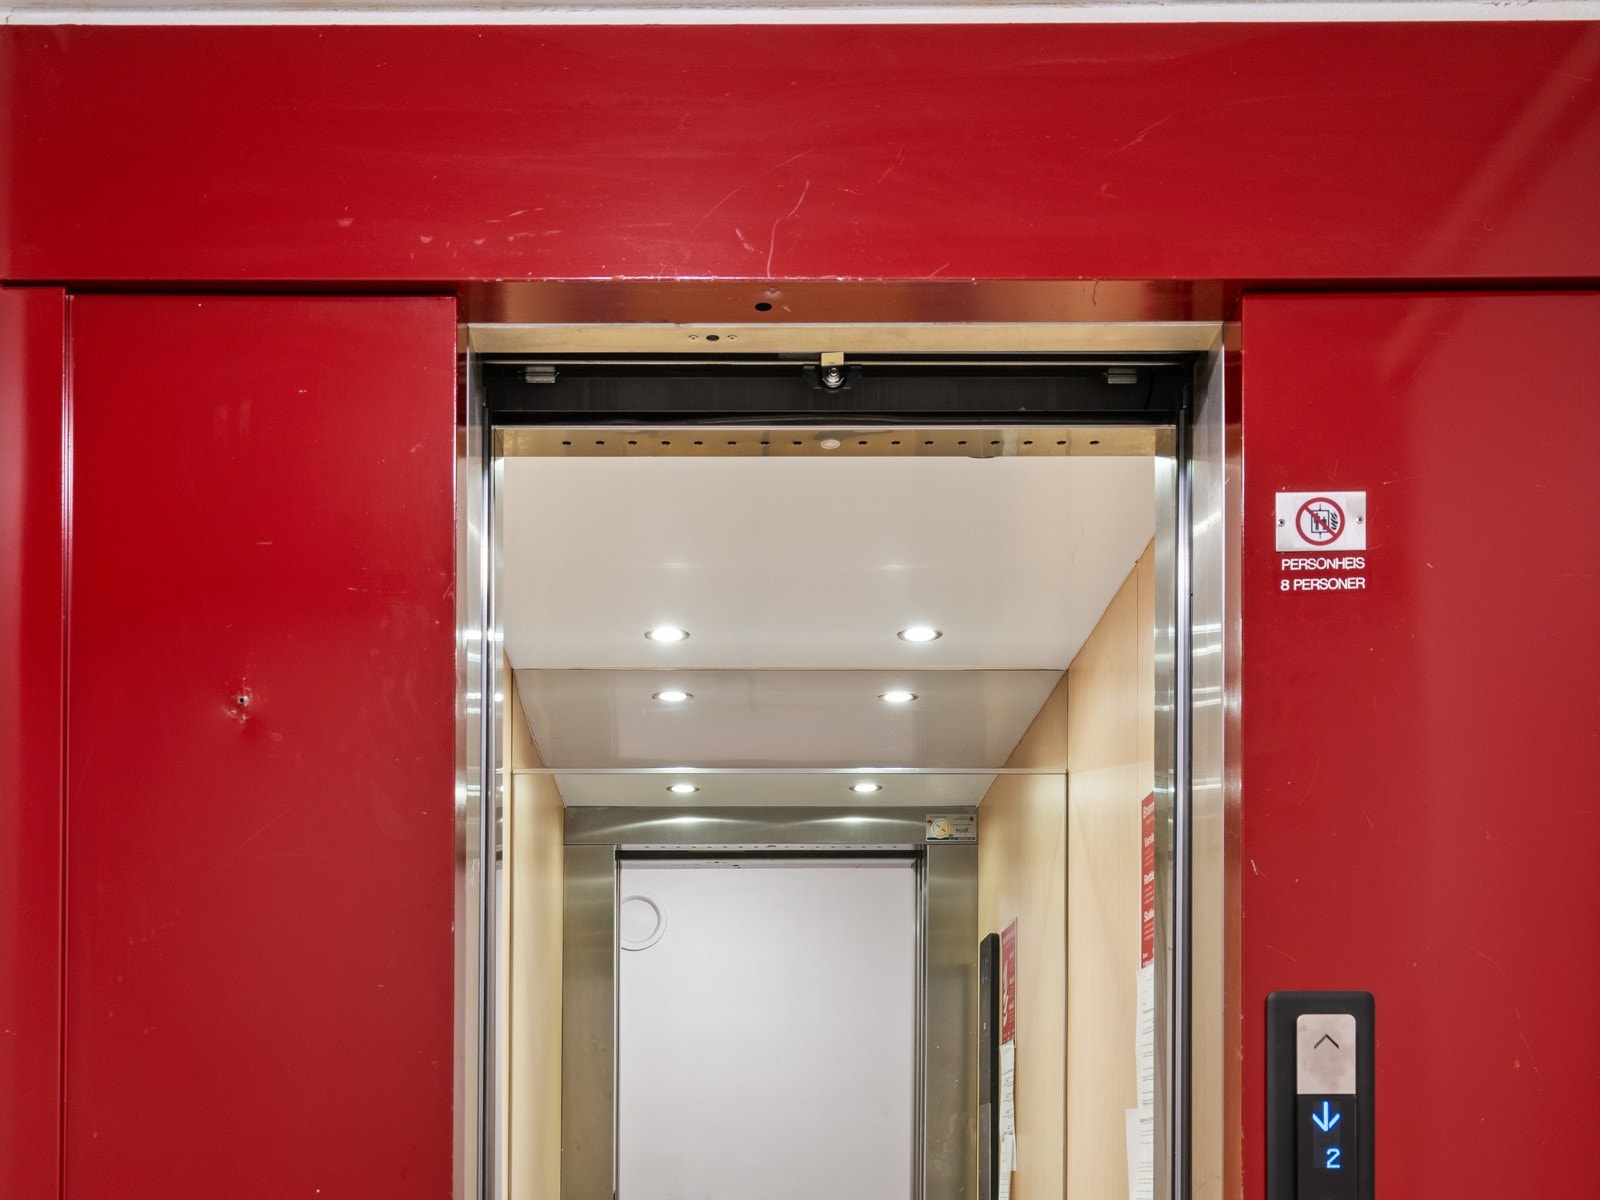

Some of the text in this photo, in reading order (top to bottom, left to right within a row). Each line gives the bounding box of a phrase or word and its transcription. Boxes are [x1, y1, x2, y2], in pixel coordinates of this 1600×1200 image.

[1281, 557, 1365, 570] PERSONHEIS
[1280, 577, 1366, 591] 8 PERSONER
[1327, 1148, 1341, 1169] 2
